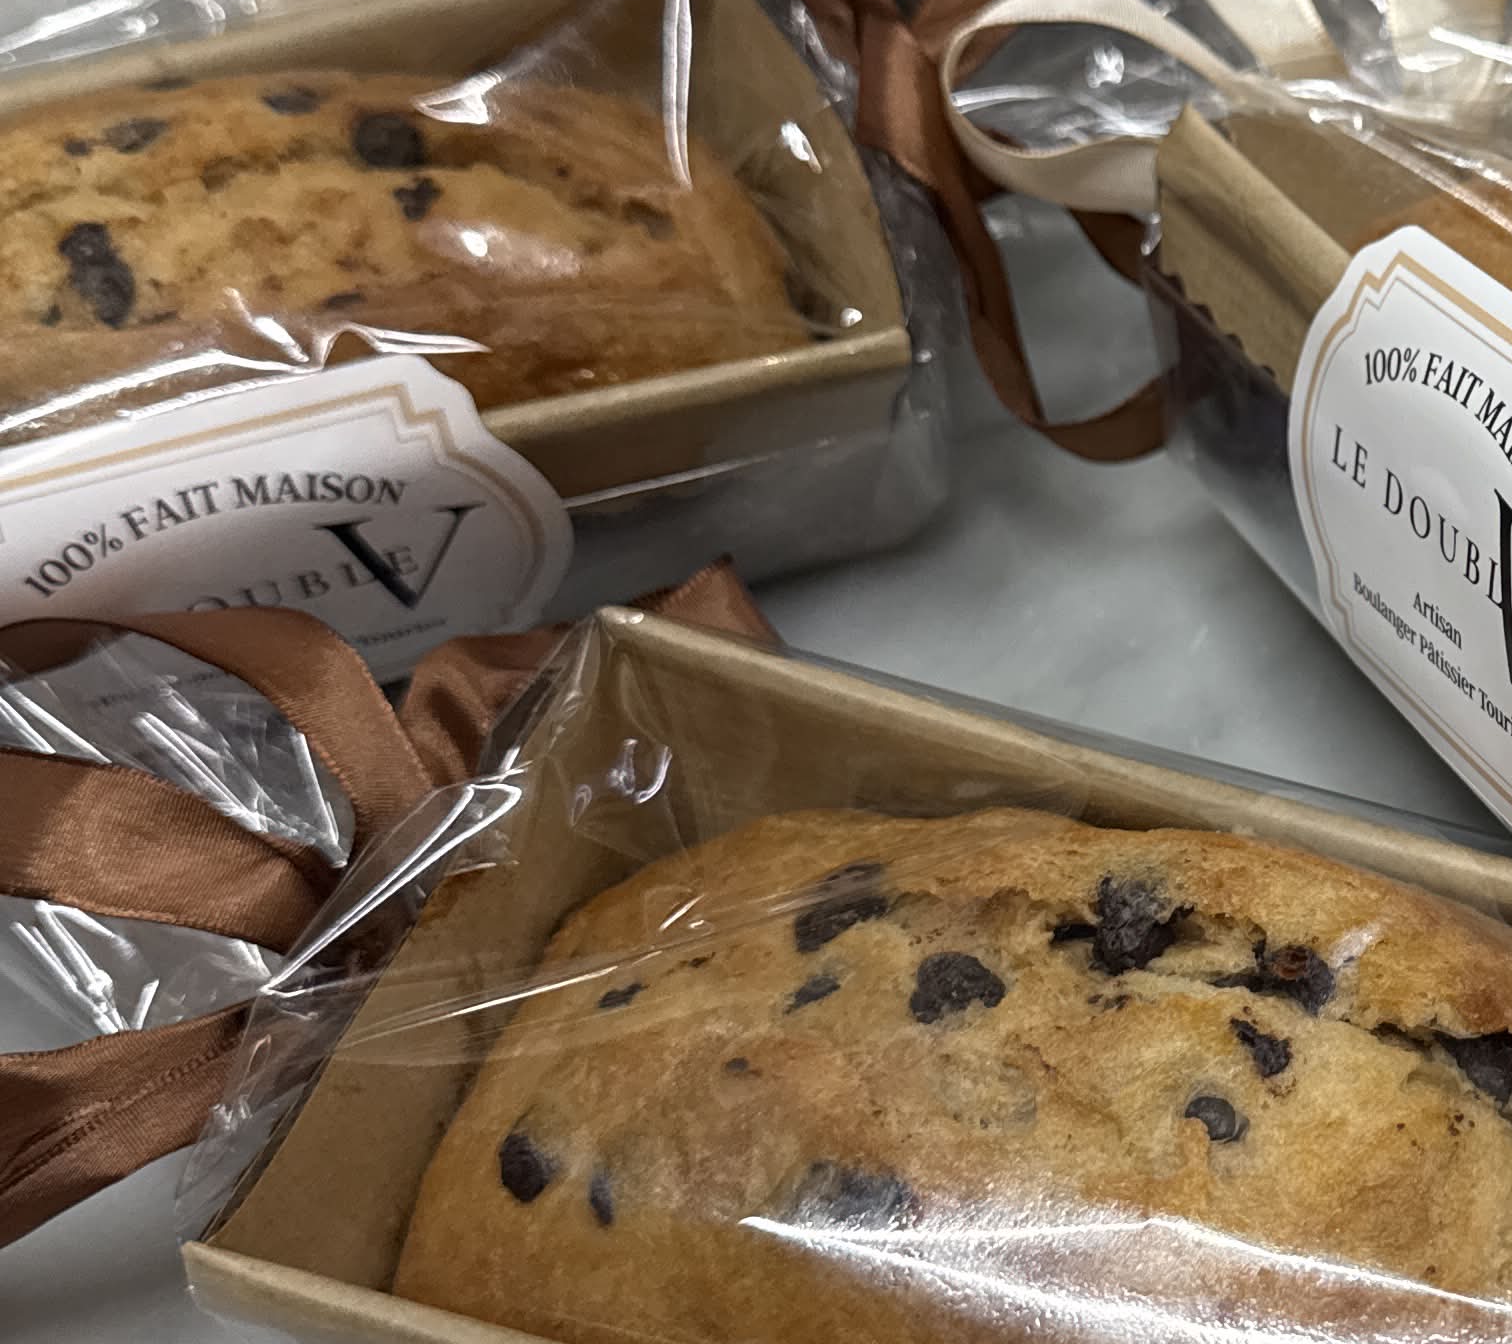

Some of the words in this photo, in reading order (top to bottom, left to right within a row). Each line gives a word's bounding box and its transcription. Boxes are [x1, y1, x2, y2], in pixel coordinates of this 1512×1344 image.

[1364, 346, 1421, 386] 100%
[1421, 352, 1484, 409] FAIT
[1332, 424, 1369, 488] LE
[23, 523, 124, 599] 100%
[120, 479, 220, 542] FAIT
[231, 471, 410, 510] MAISON
[186, 544, 420, 611] UBLE
[1353, 572, 1417, 645] Boulanger
[1419, 633, 1477, 700] Pâtissier
[1413, 592, 1463, 650] Artisan
